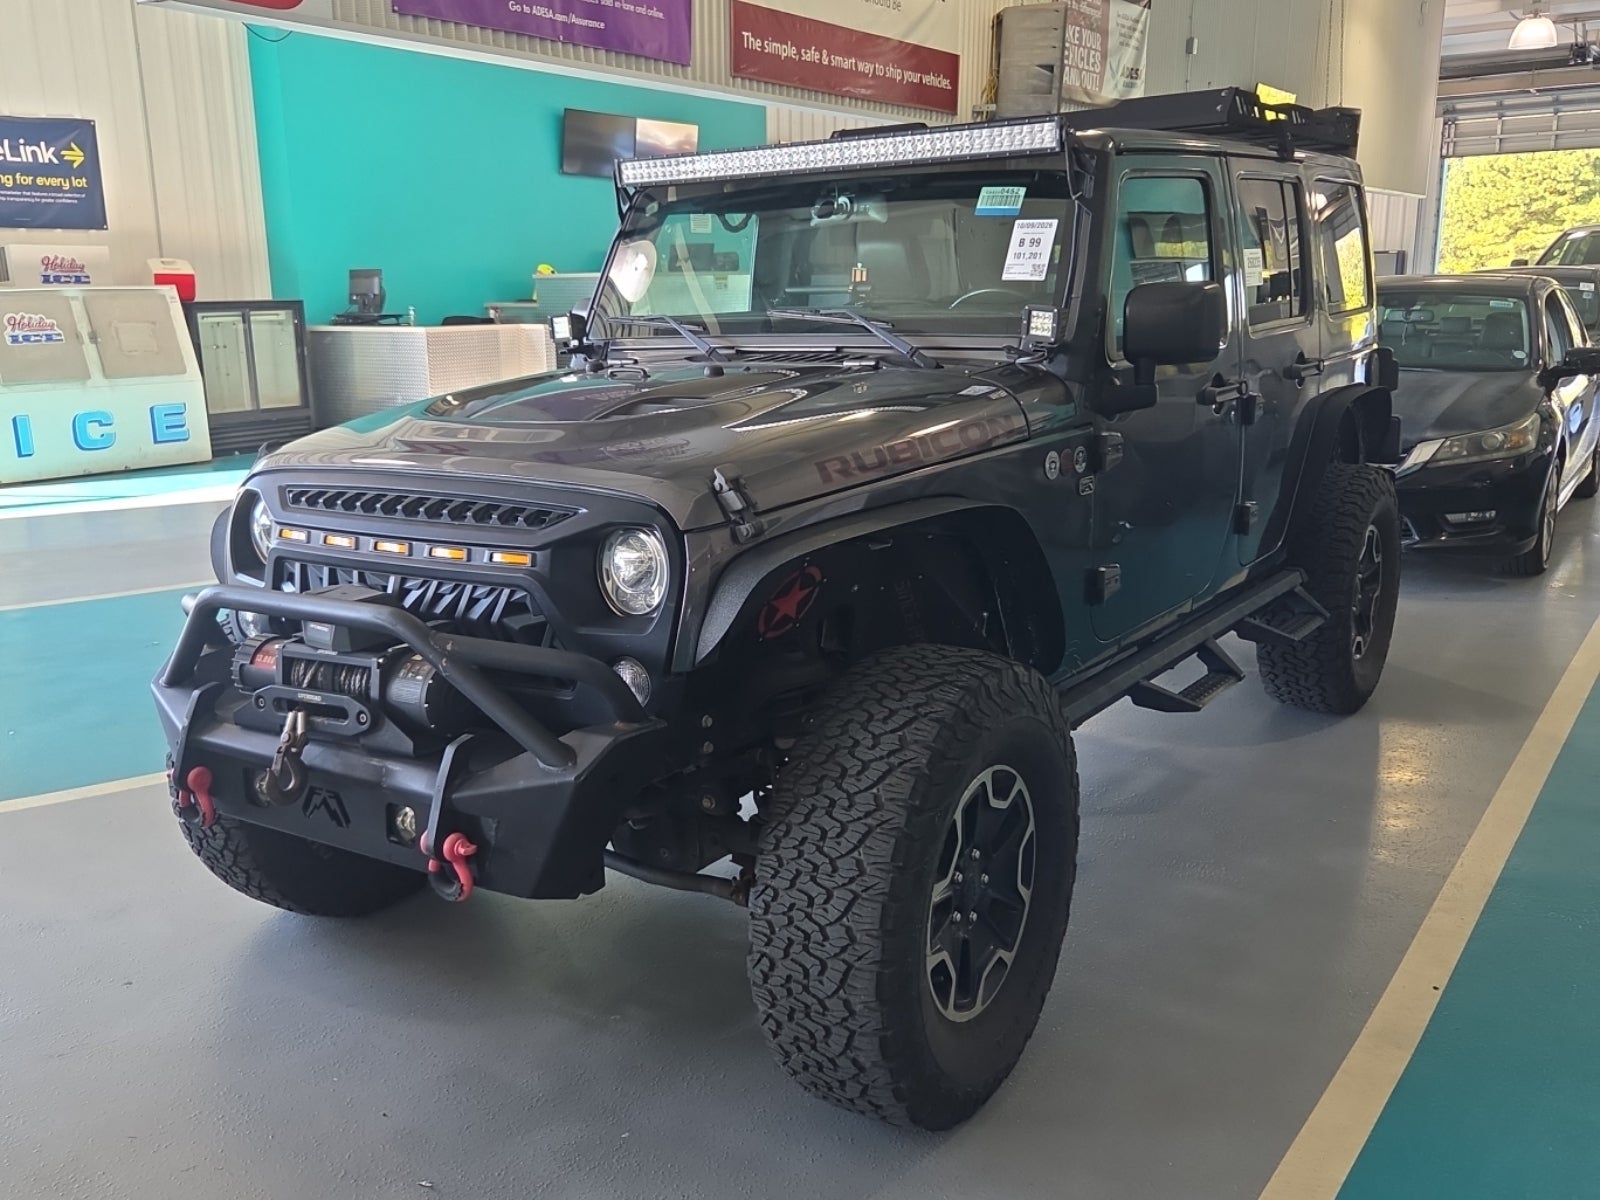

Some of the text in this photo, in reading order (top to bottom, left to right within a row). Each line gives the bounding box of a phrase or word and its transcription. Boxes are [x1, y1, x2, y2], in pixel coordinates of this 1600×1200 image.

[508, 0, 606, 30] Go to ADESA.com/Assurance
[1081, 28, 1102, 51] YOUR
[741, 31, 953, 90] The simple, safe & smart way to ship your vehicles.
[1081, 71, 1100, 91] OUT!
[15, 172, 34, 186] for
[36, 176, 70, 190] every
[71, 176, 88, 188] lot
[1028, 237, 1042, 248] 99
[41, 255, 86, 273] Holiday
[1013, 251, 1042, 261] 101,201
[7, 314, 57, 332] Holiday
[12, 402, 190, 458] ICE
[813, 414, 1015, 485] RUBICON
